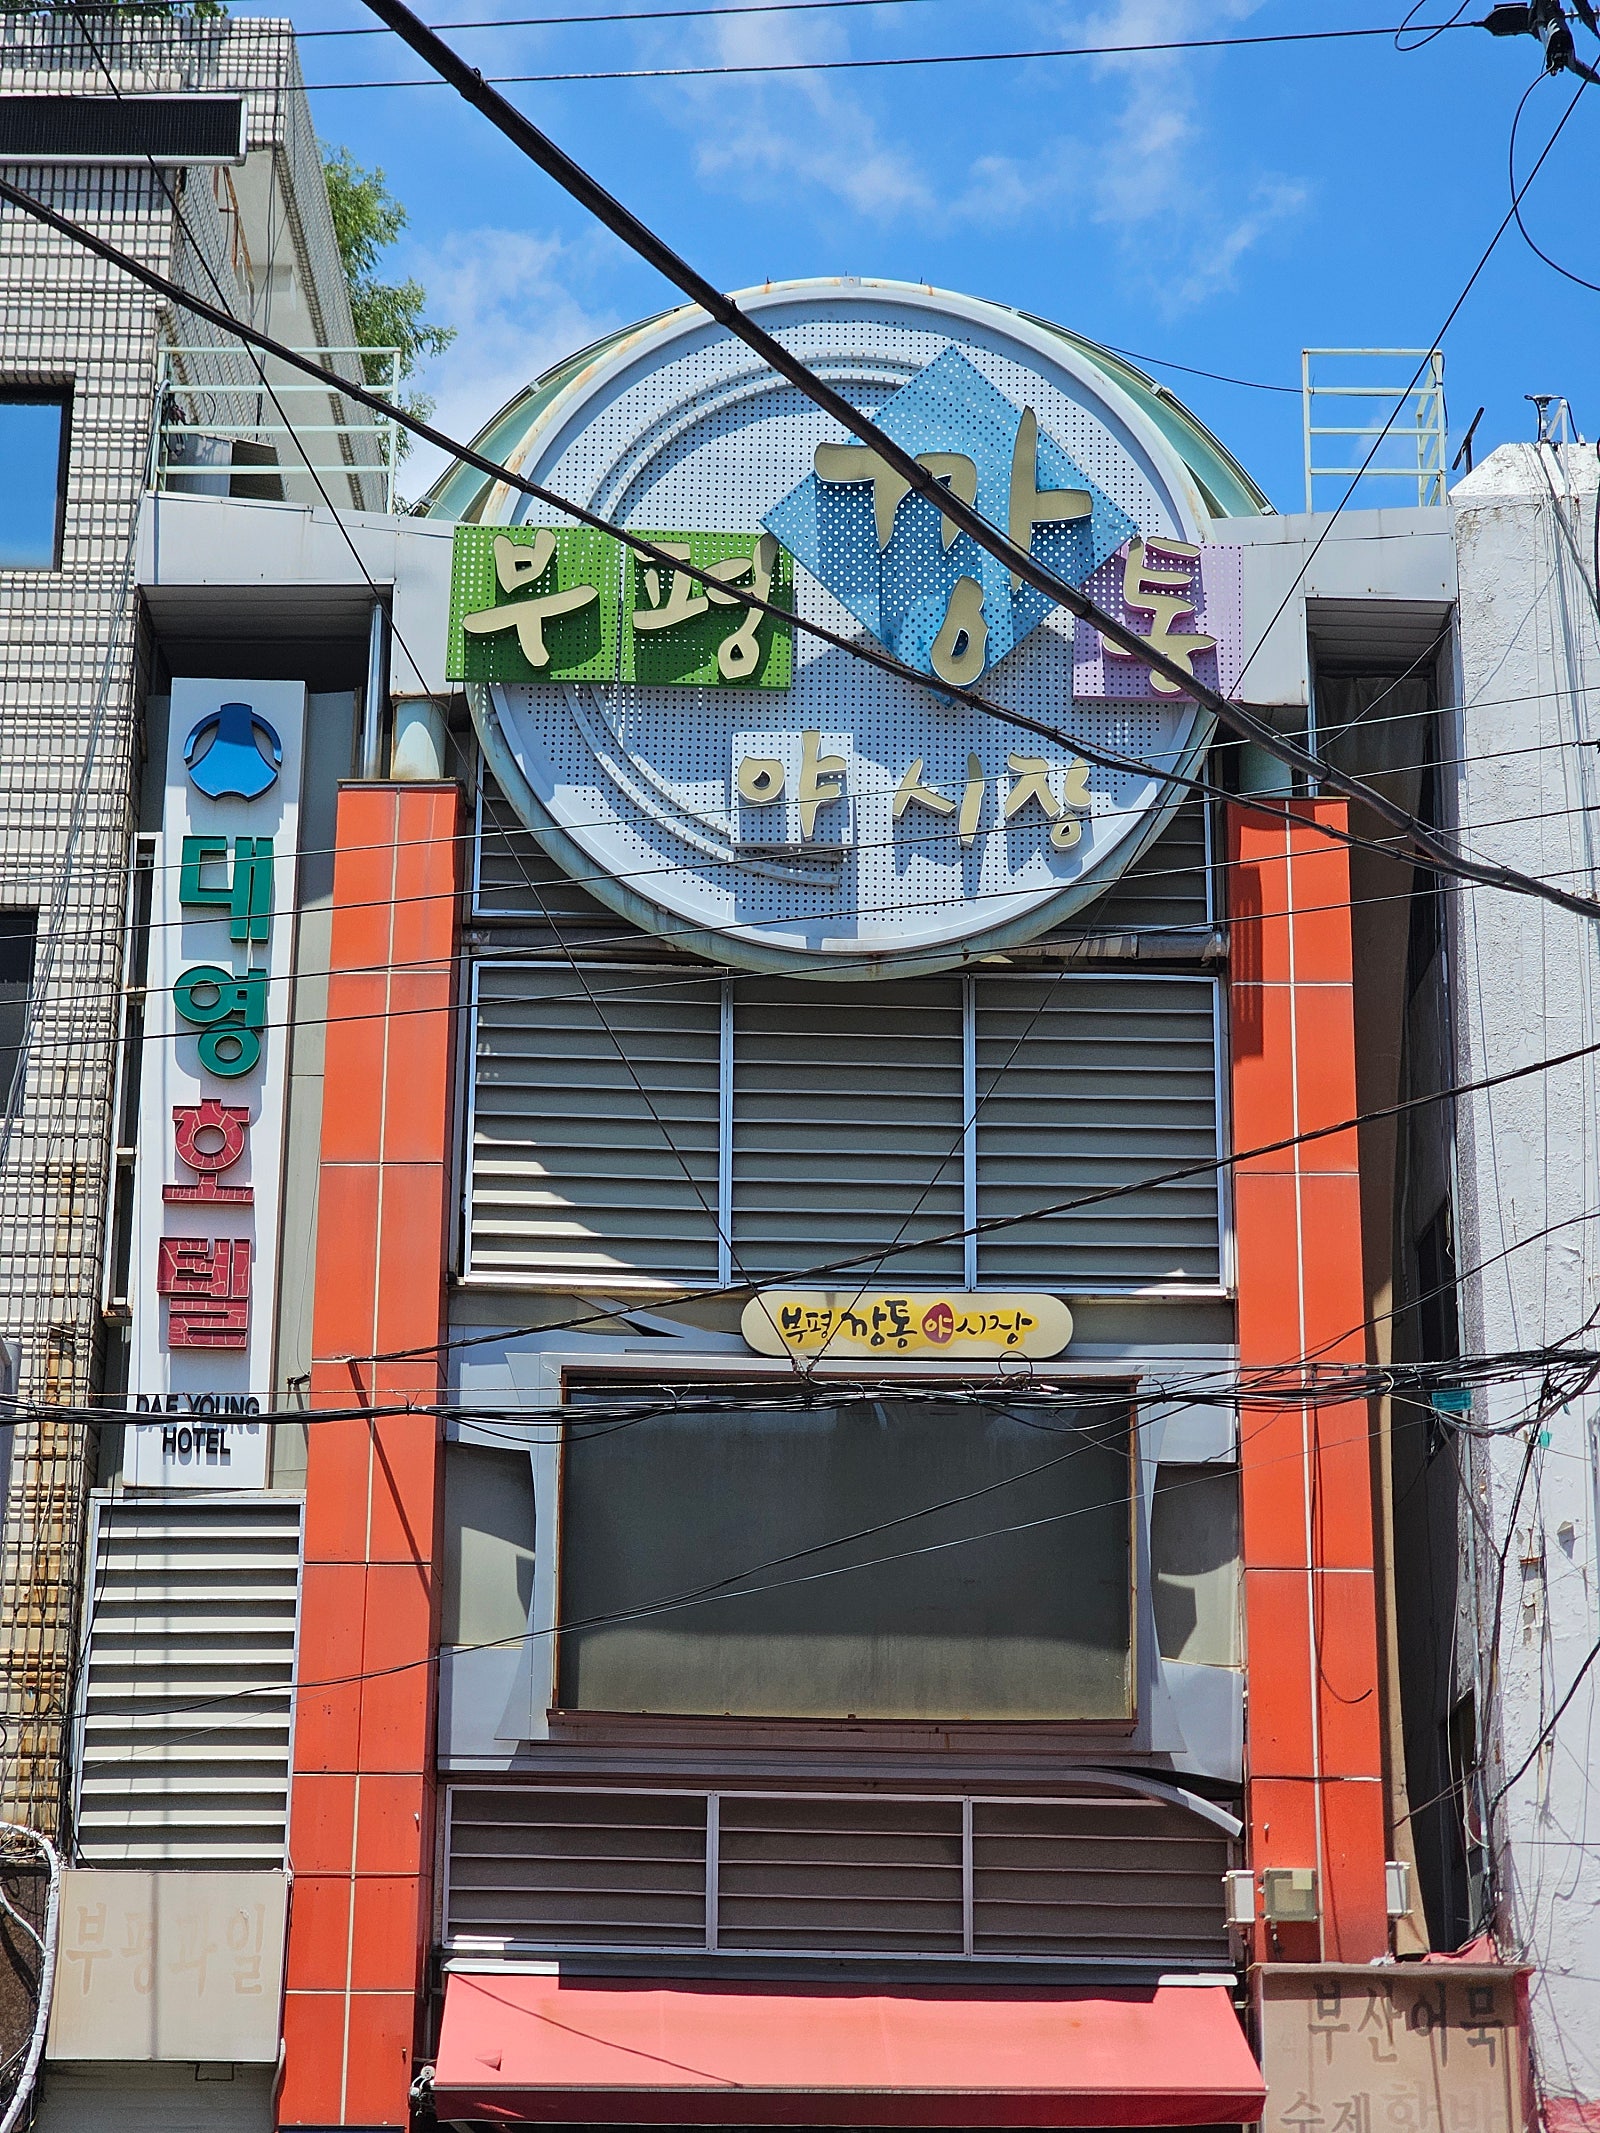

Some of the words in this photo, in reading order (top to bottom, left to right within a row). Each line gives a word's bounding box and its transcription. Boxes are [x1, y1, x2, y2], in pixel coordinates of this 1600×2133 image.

[462, 527, 781, 681] 부평
[813, 405, 1219, 696] 깡통
[738, 729, 1094, 852] 야시장
[136, 1394, 180, 1420] DAE
[186, 1394, 260, 1421] YOUNG
[162, 1427, 231, 1453] HOTEL
[1307, 1980, 1507, 2067] 부산어묵
